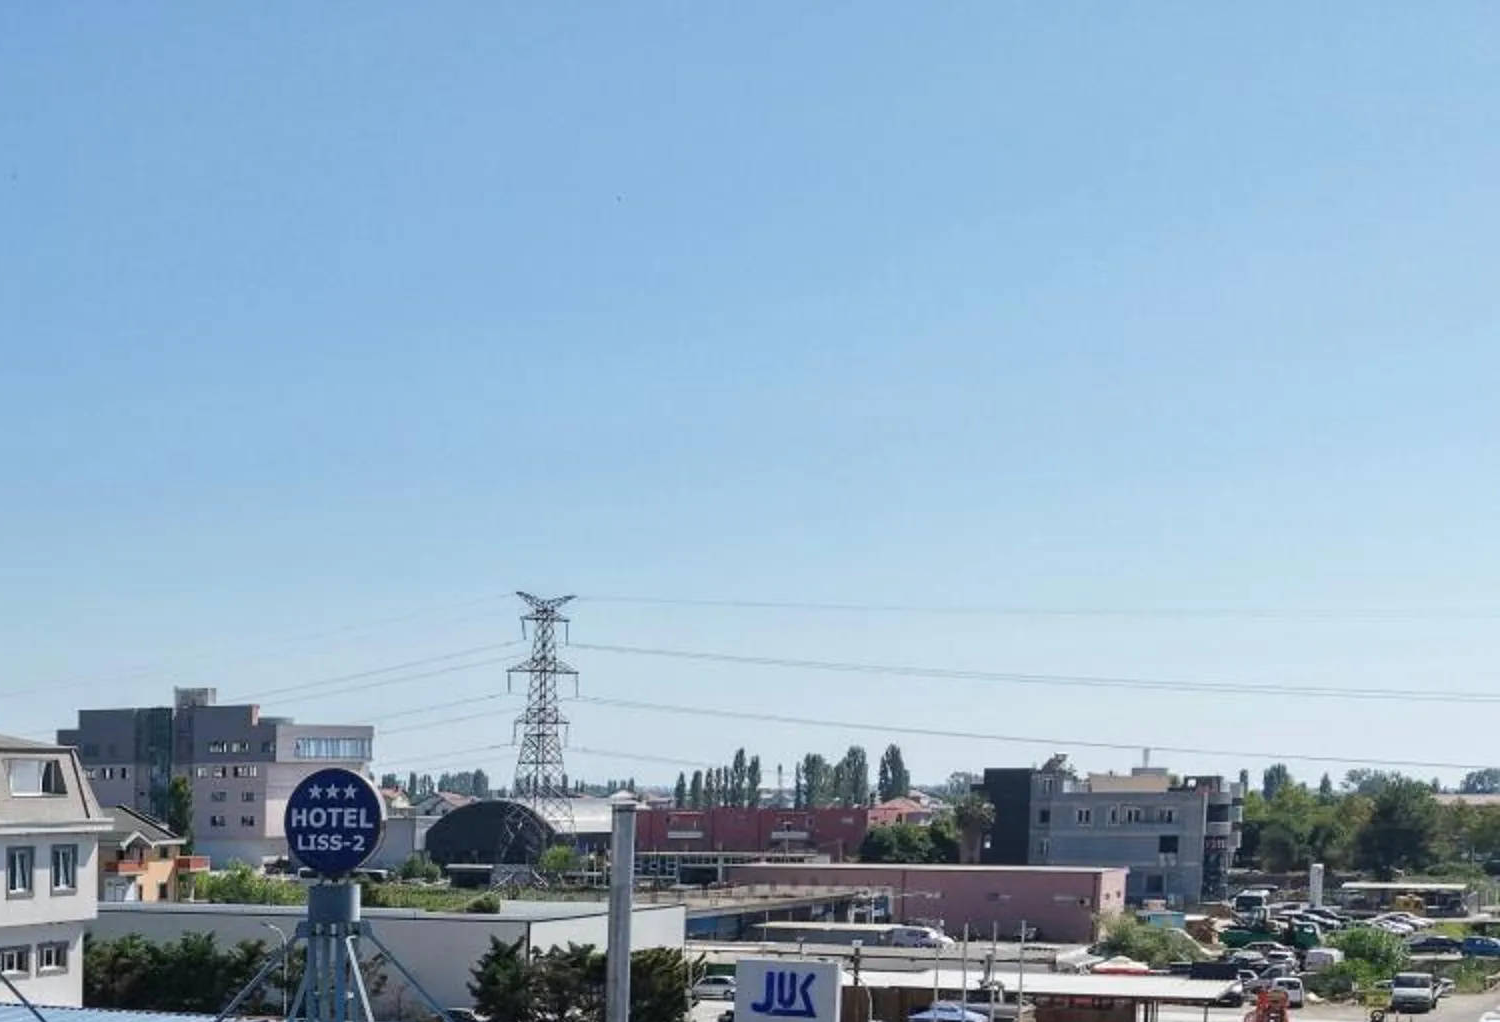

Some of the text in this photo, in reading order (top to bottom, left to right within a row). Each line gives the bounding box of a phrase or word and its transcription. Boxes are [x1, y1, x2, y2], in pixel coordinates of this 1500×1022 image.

[291, 807, 374, 829] HOTEL
[297, 833, 365, 851] LISS-2
[750, 970, 817, 1018] JUK
